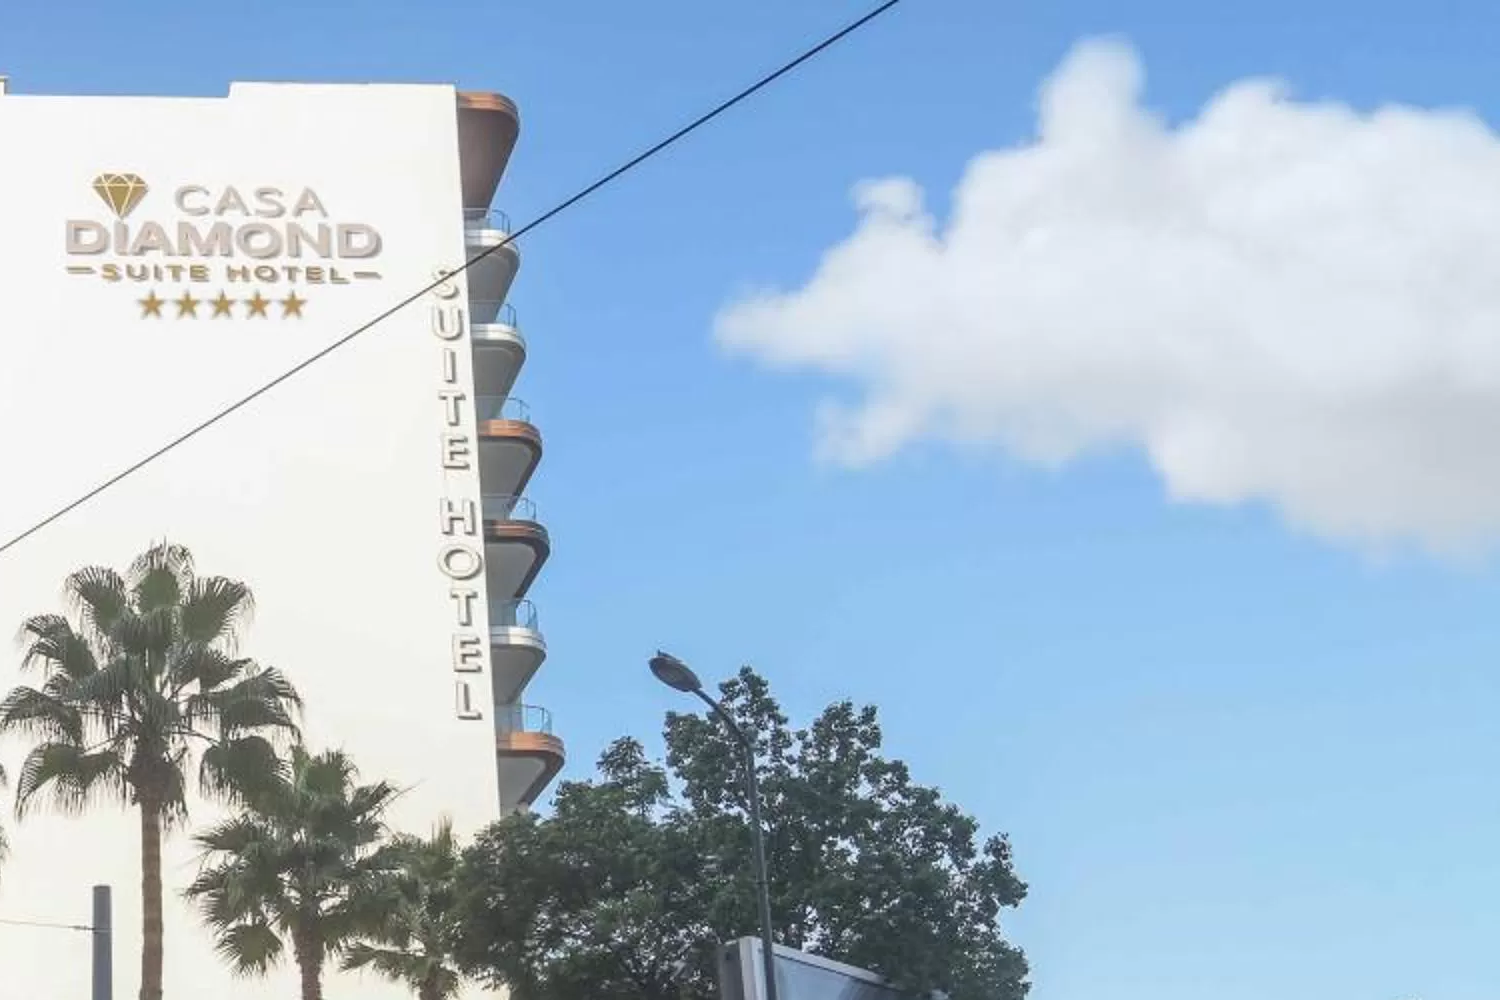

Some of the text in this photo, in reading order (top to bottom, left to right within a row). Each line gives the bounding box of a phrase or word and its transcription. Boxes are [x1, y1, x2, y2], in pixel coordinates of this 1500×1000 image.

[174, 183, 329, 219] CASA
[65, 219, 385, 260] DIAMOND
[102, 263, 351, 285] SUITE HOTEL
[431, 266, 484, 722] SUITE HOTEL
